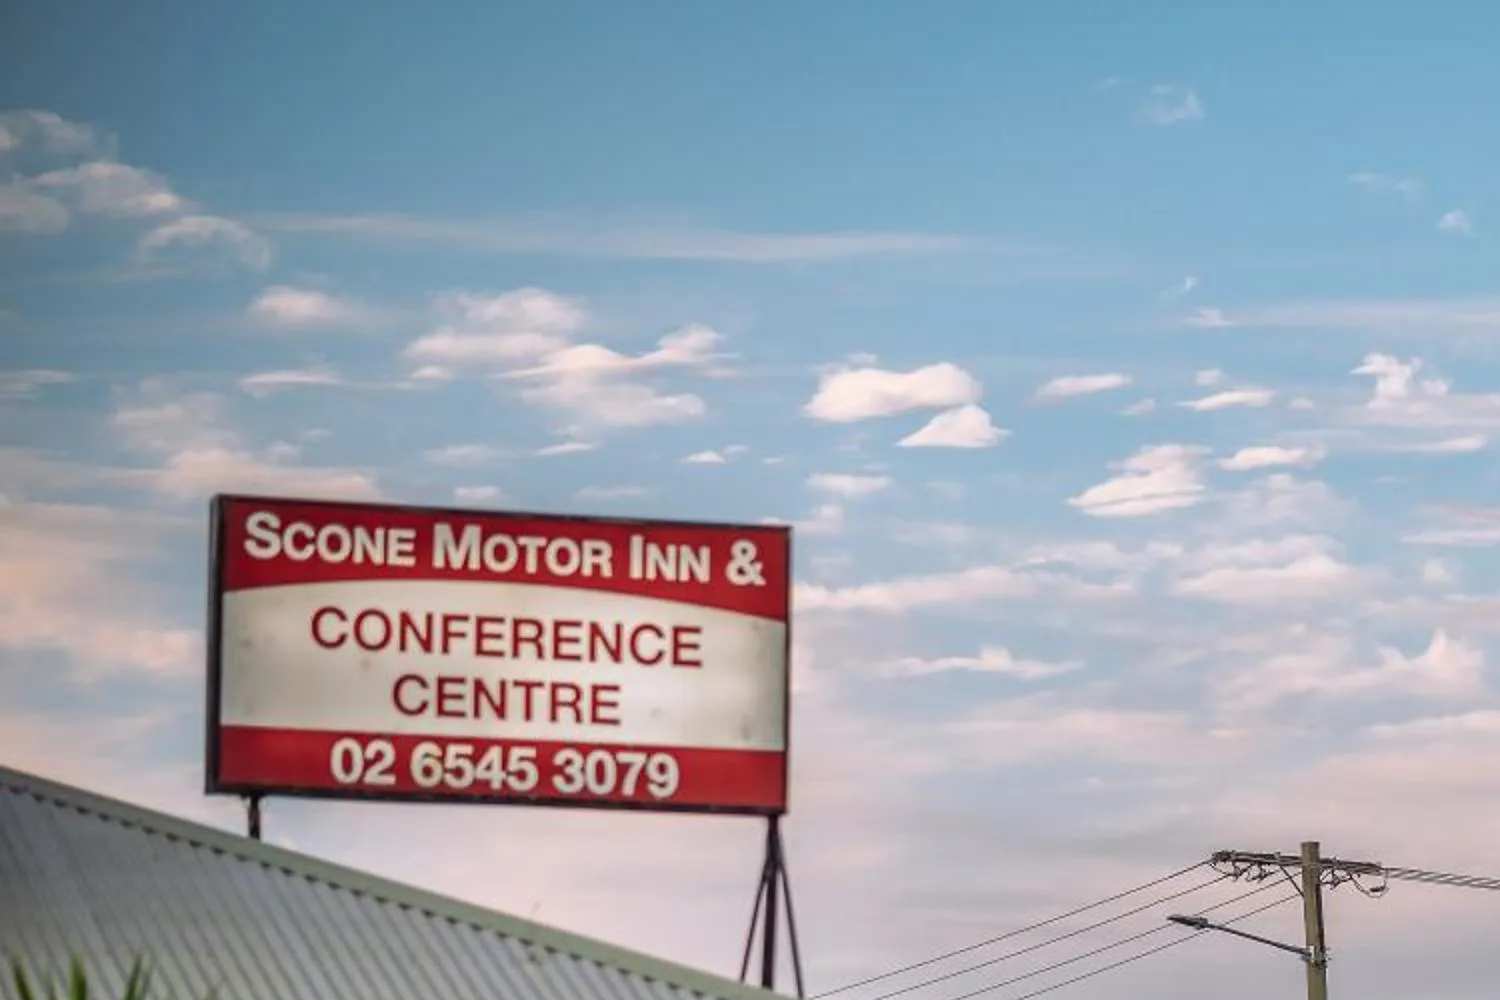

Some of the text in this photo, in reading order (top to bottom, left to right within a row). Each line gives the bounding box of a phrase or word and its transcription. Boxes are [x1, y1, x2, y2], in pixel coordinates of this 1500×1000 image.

[244, 511, 767, 587] SCONE MOTOR INN &
[310, 606, 703, 668] CONFERENCE
[392, 674, 622, 726] CENTRE
[330, 738, 680, 799] 02 6545 3079
